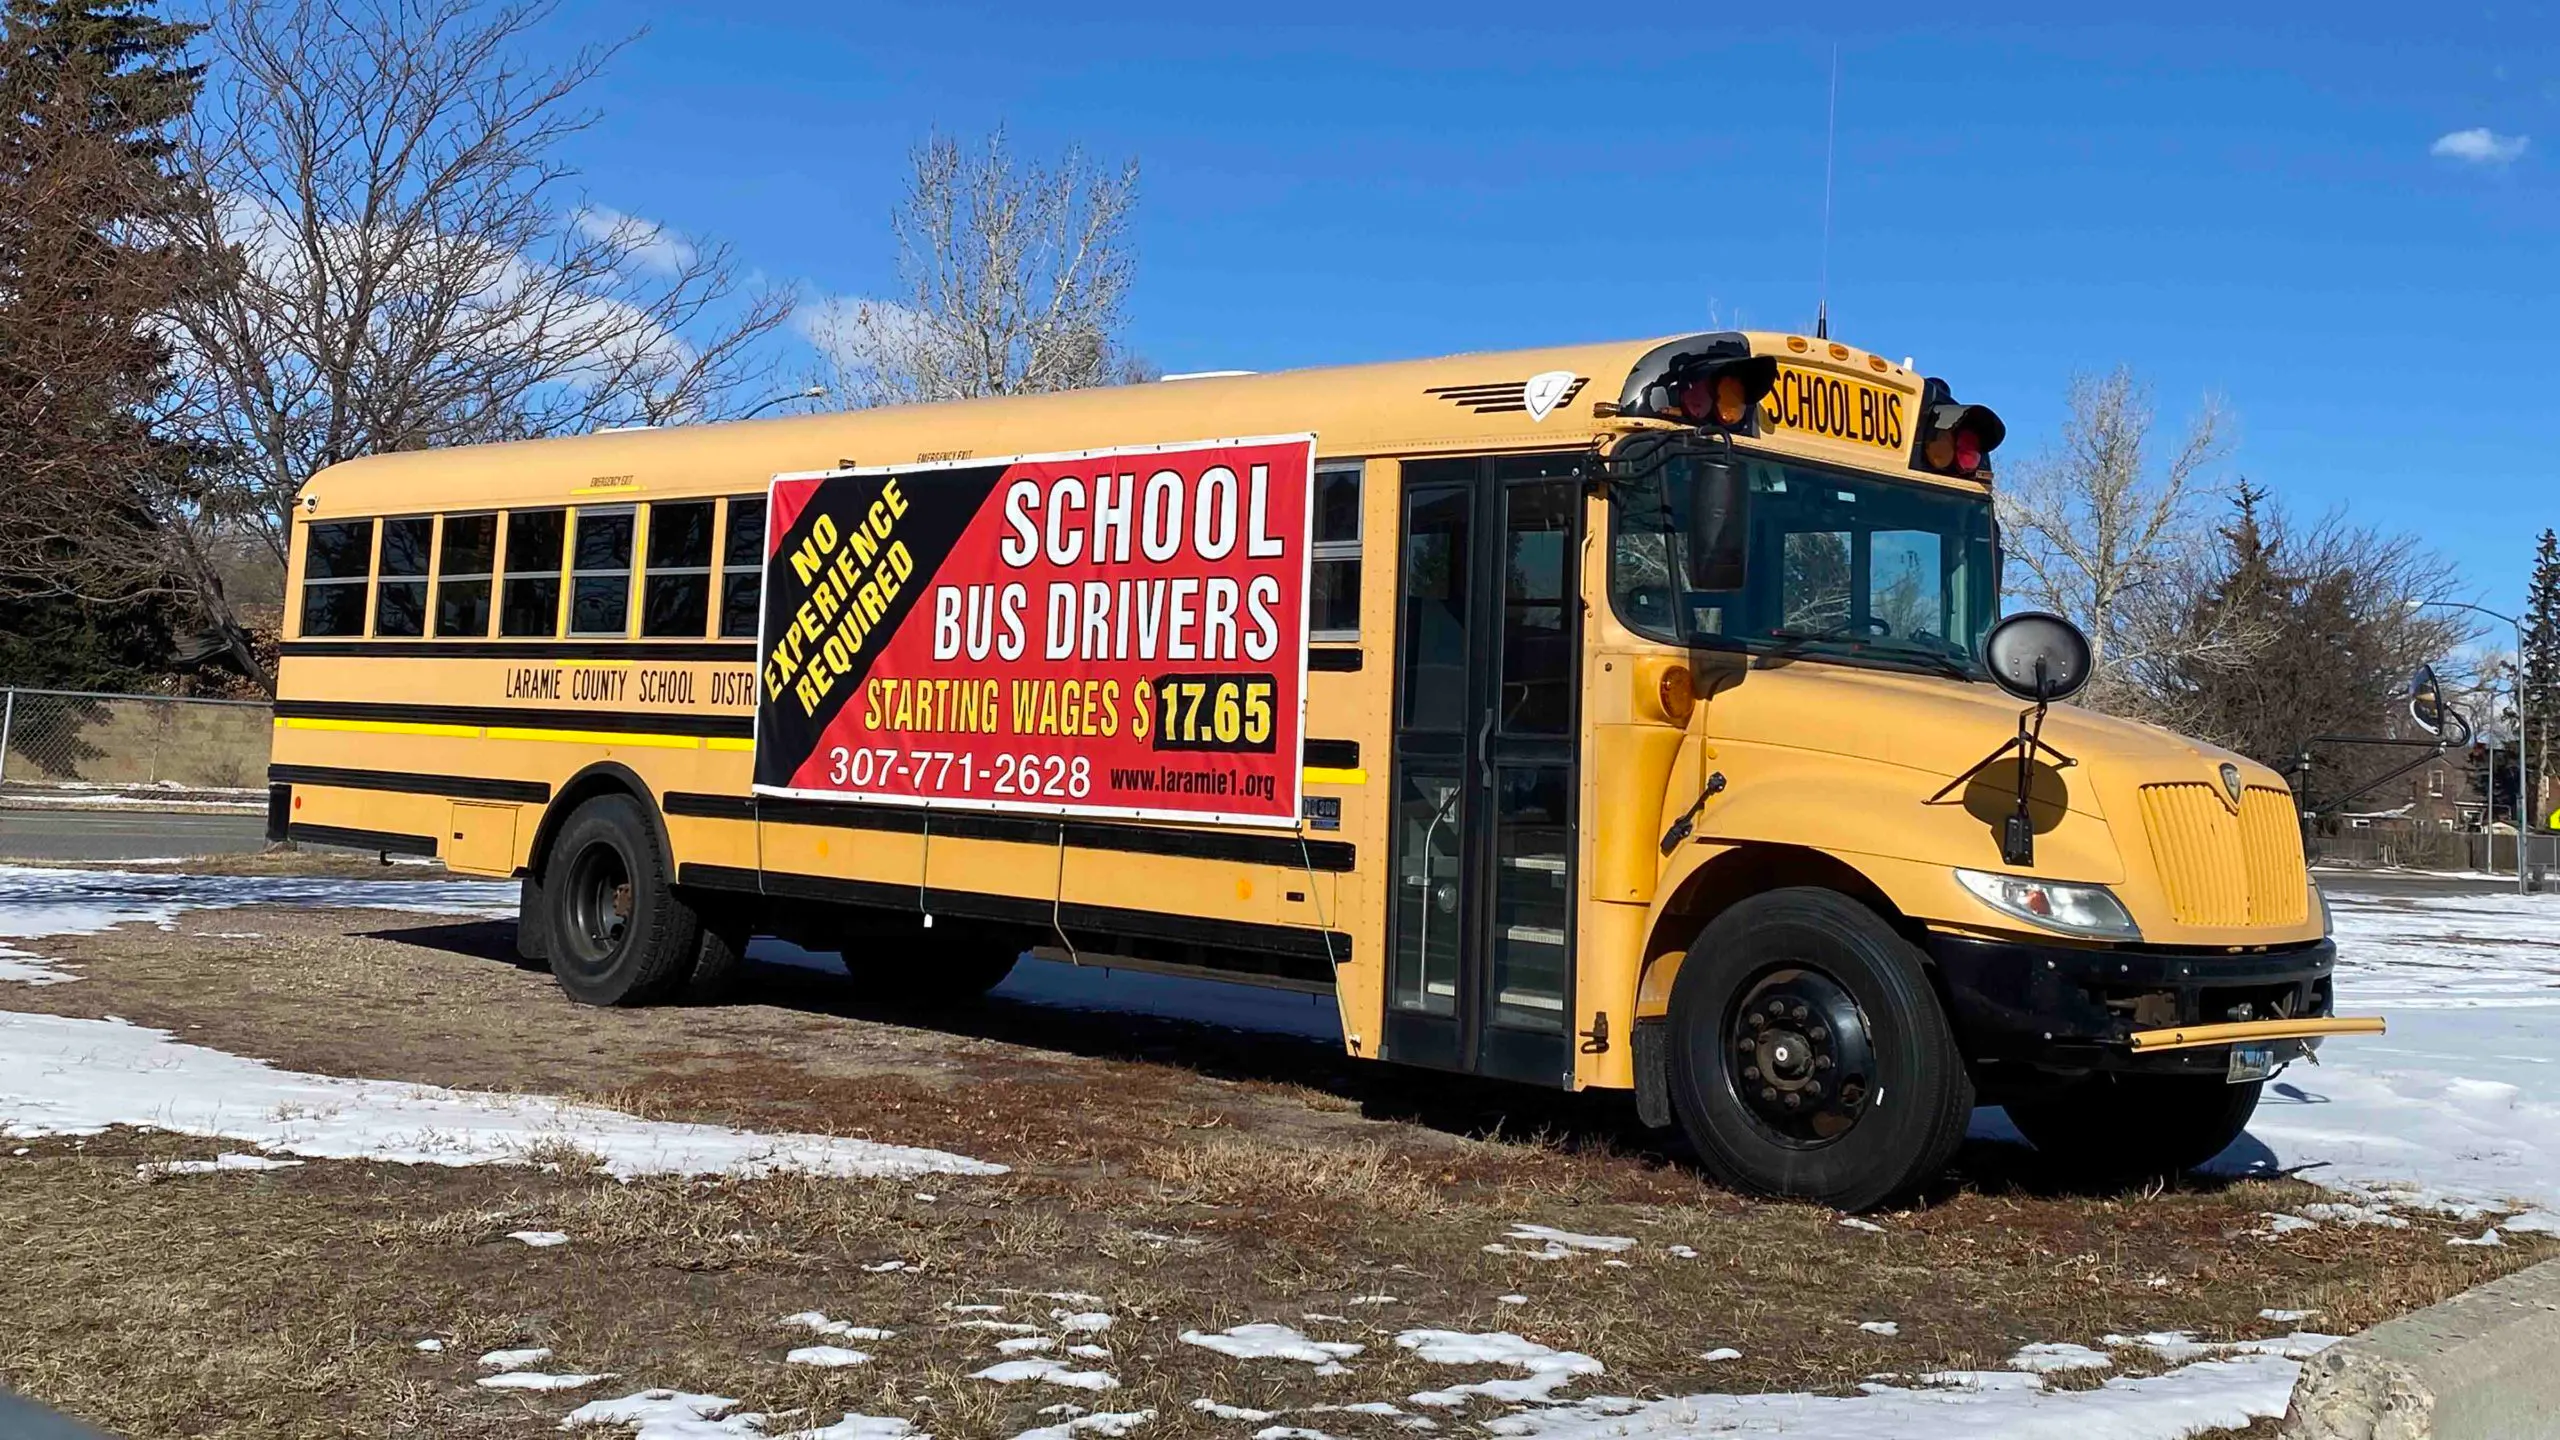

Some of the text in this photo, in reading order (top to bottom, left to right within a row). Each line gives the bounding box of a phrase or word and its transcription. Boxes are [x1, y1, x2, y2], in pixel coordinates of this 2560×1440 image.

[1768, 369, 1902, 449] SCHOOL BUS
[790, 513, 838, 587] NO
[1000, 462, 1285, 568] SCHOOL
[764, 478, 909, 702] EXPERIENCE
[933, 574, 1281, 662] BUS DRIVERS
[795, 540, 913, 718] REQUIRED
[506, 668, 562, 699] LARAMIE
[572, 669, 627, 702] COUNTY
[639, 670, 695, 704] SCHOOL
[865, 677, 999, 734] STARTING
[1011, 678, 1121, 738] WAGES
[829, 746, 1091, 798] 307-771-2628
[1110, 766, 1275, 801] www.laramie1.org
